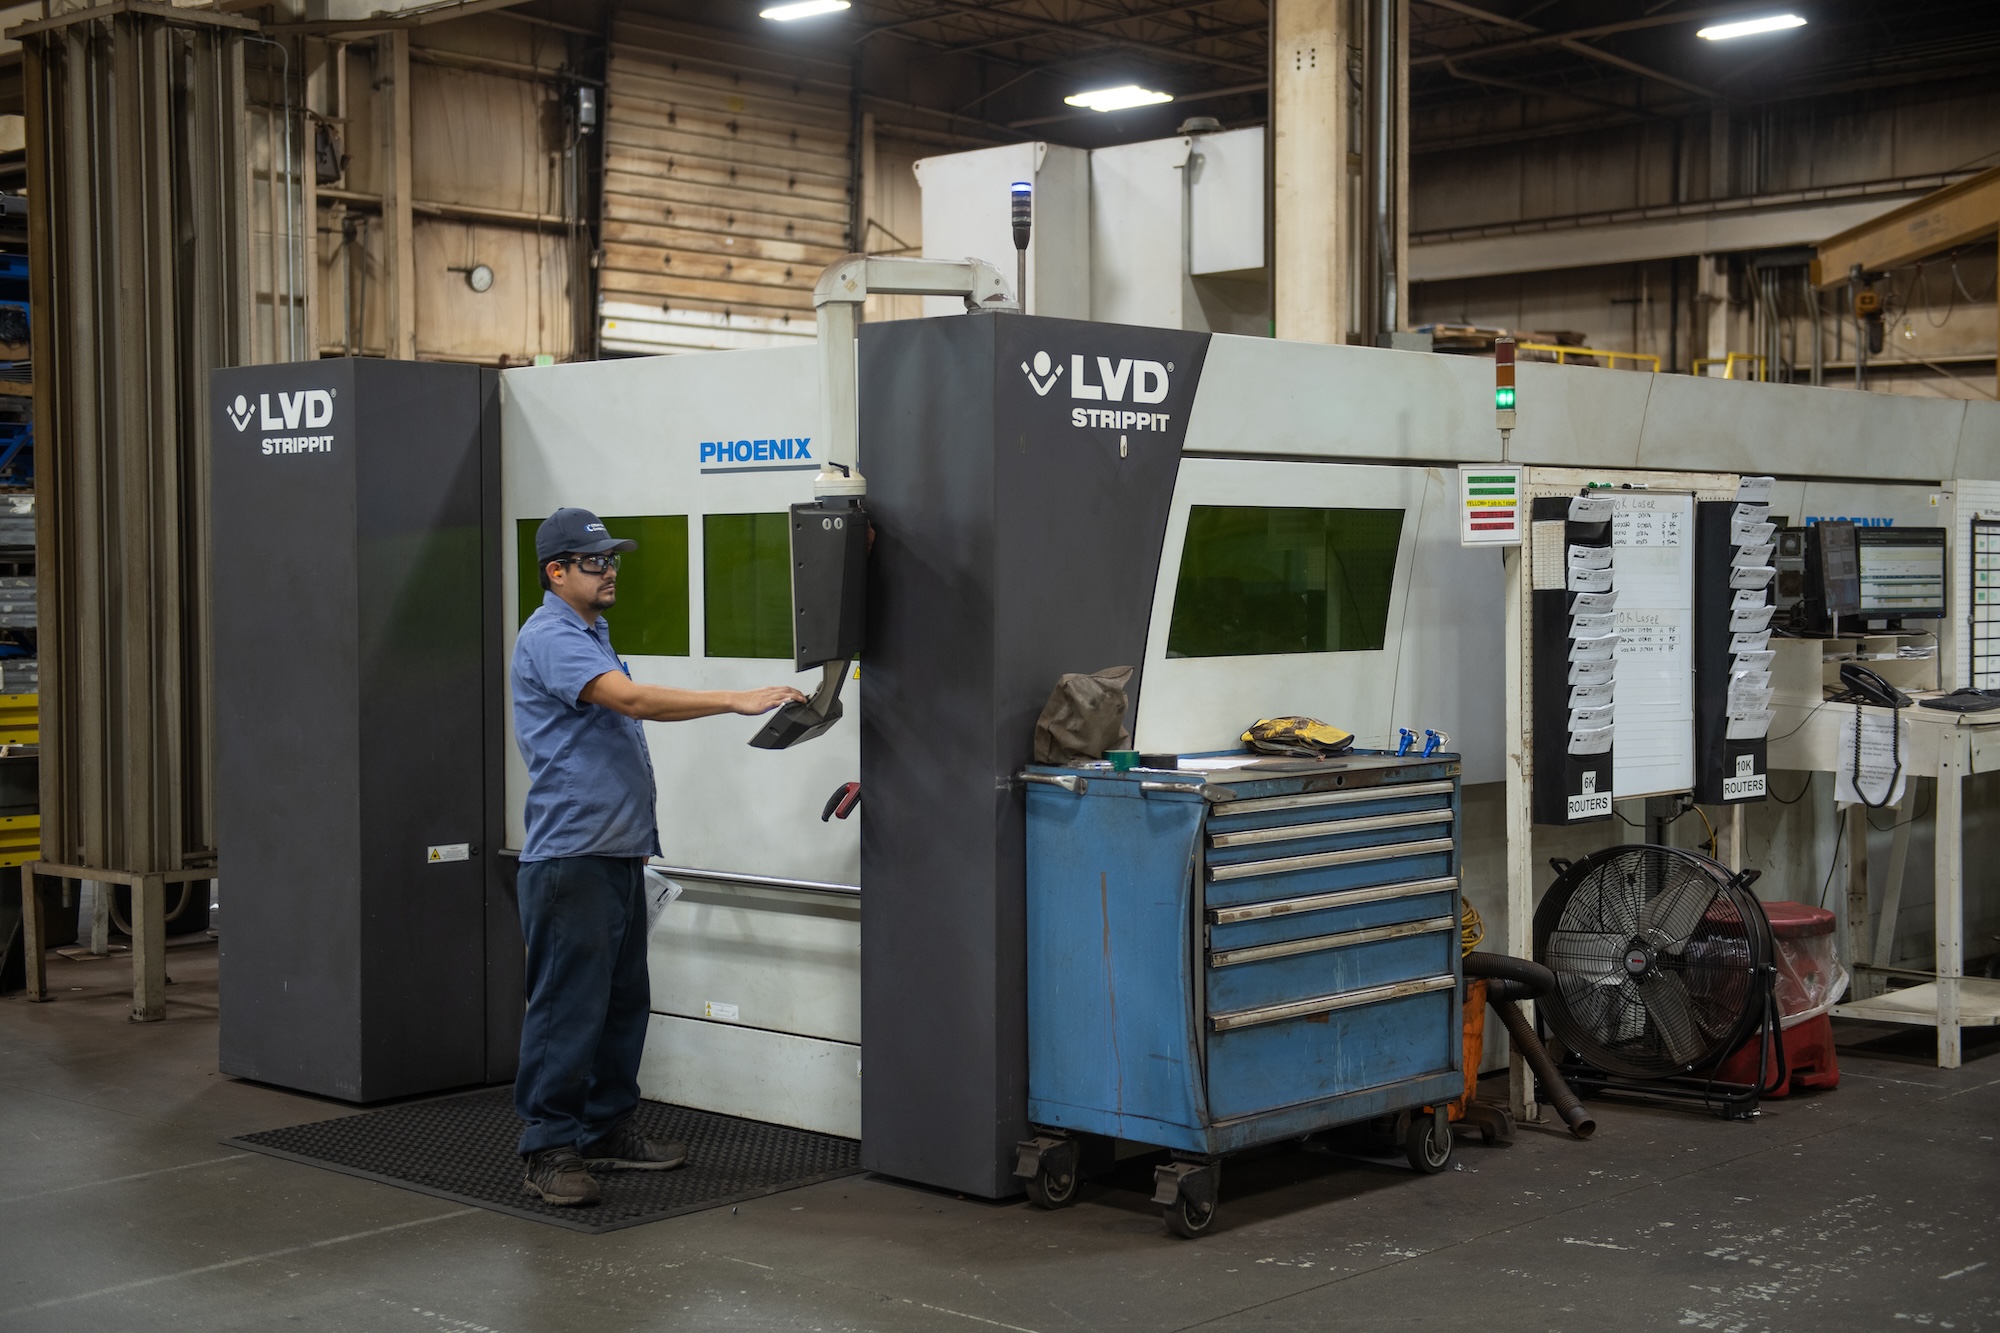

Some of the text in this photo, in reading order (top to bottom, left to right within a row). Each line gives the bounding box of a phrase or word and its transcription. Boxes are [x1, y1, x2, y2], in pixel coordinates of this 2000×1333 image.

[1071, 354, 1169, 404] LVD
[260, 389, 333, 430] LVD
[1072, 407, 1170, 432] STRIPPIT
[262, 435, 334, 455] STRIPPIT
[700, 438, 812, 463] PHOENIX
[1737, 760, 1752, 771] 10K
[1584, 776, 1595, 788] 6K
[1725, 779, 1764, 794] ROUTERS
[1569, 797, 1608, 813] ROUTERS
